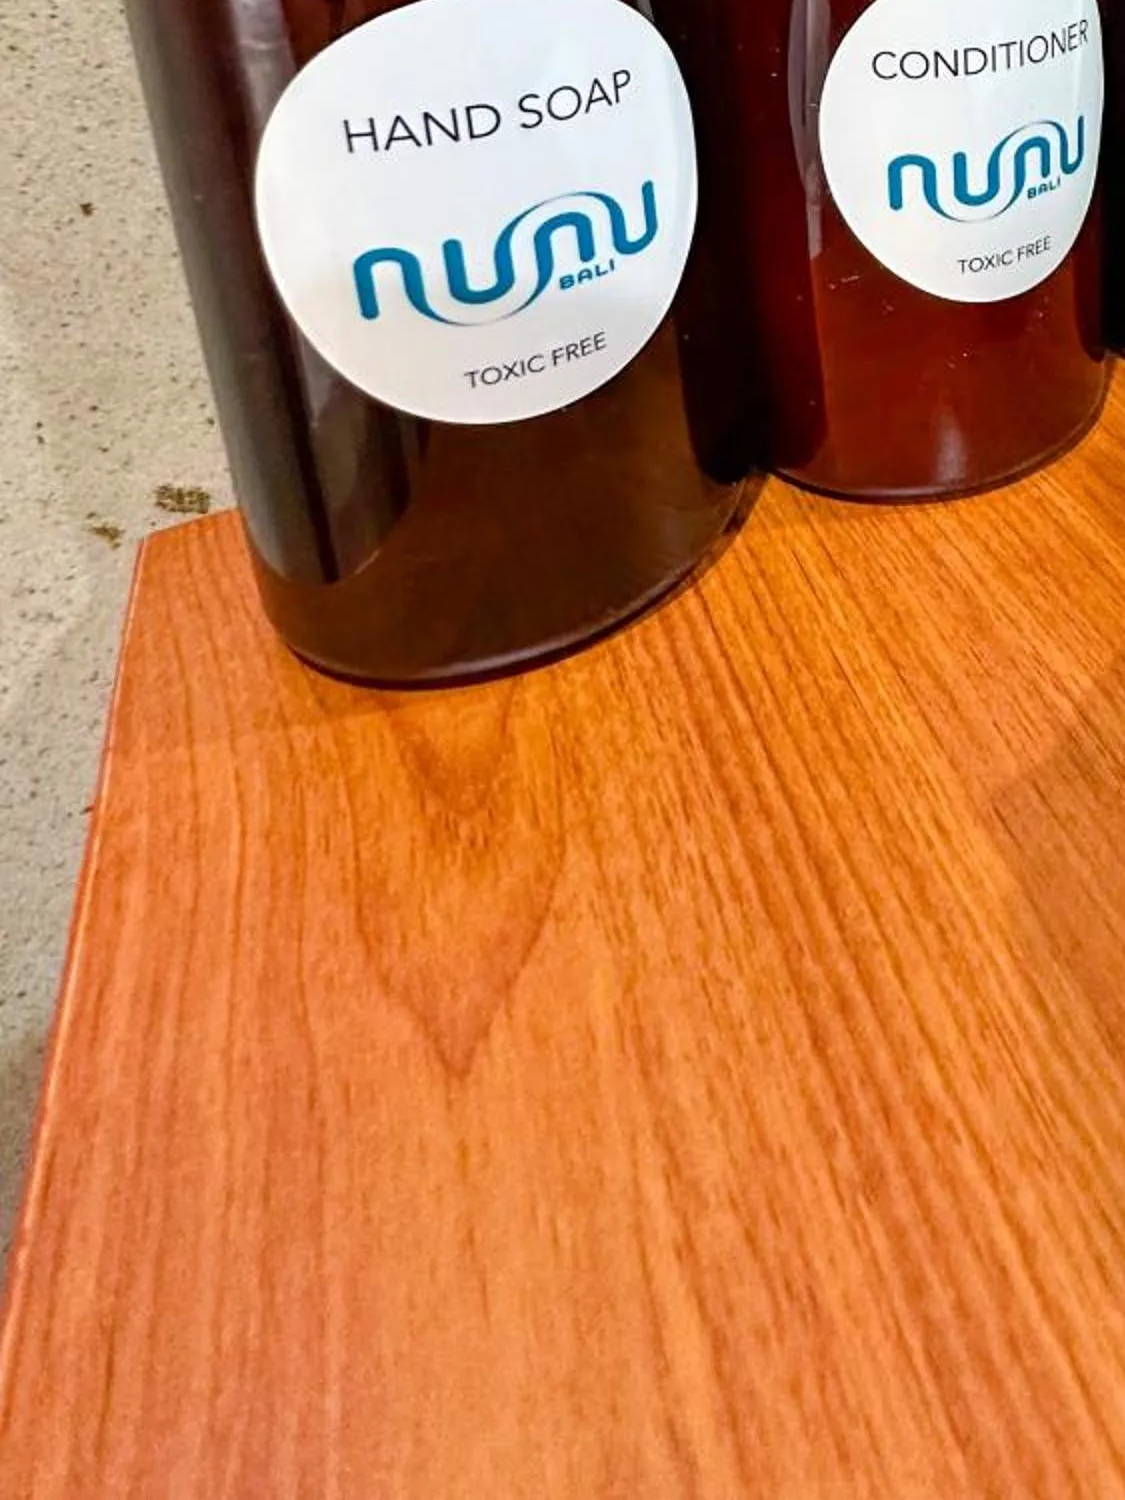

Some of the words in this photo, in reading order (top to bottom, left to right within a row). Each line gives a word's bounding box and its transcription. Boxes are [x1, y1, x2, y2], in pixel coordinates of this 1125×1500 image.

[871, 18, 1089, 81] CONDITIONER
[343, 103, 501, 153] HAND
[518, 69, 631, 129] SOAP
[1027, 176, 1061, 200] BALI
[558, 262, 616, 290] BALI
[957, 249, 1013, 274] TOXIC
[1017, 235, 1052, 262] FREE
[463, 354, 546, 389] TOXIC
[552, 331, 608, 367] FREE
